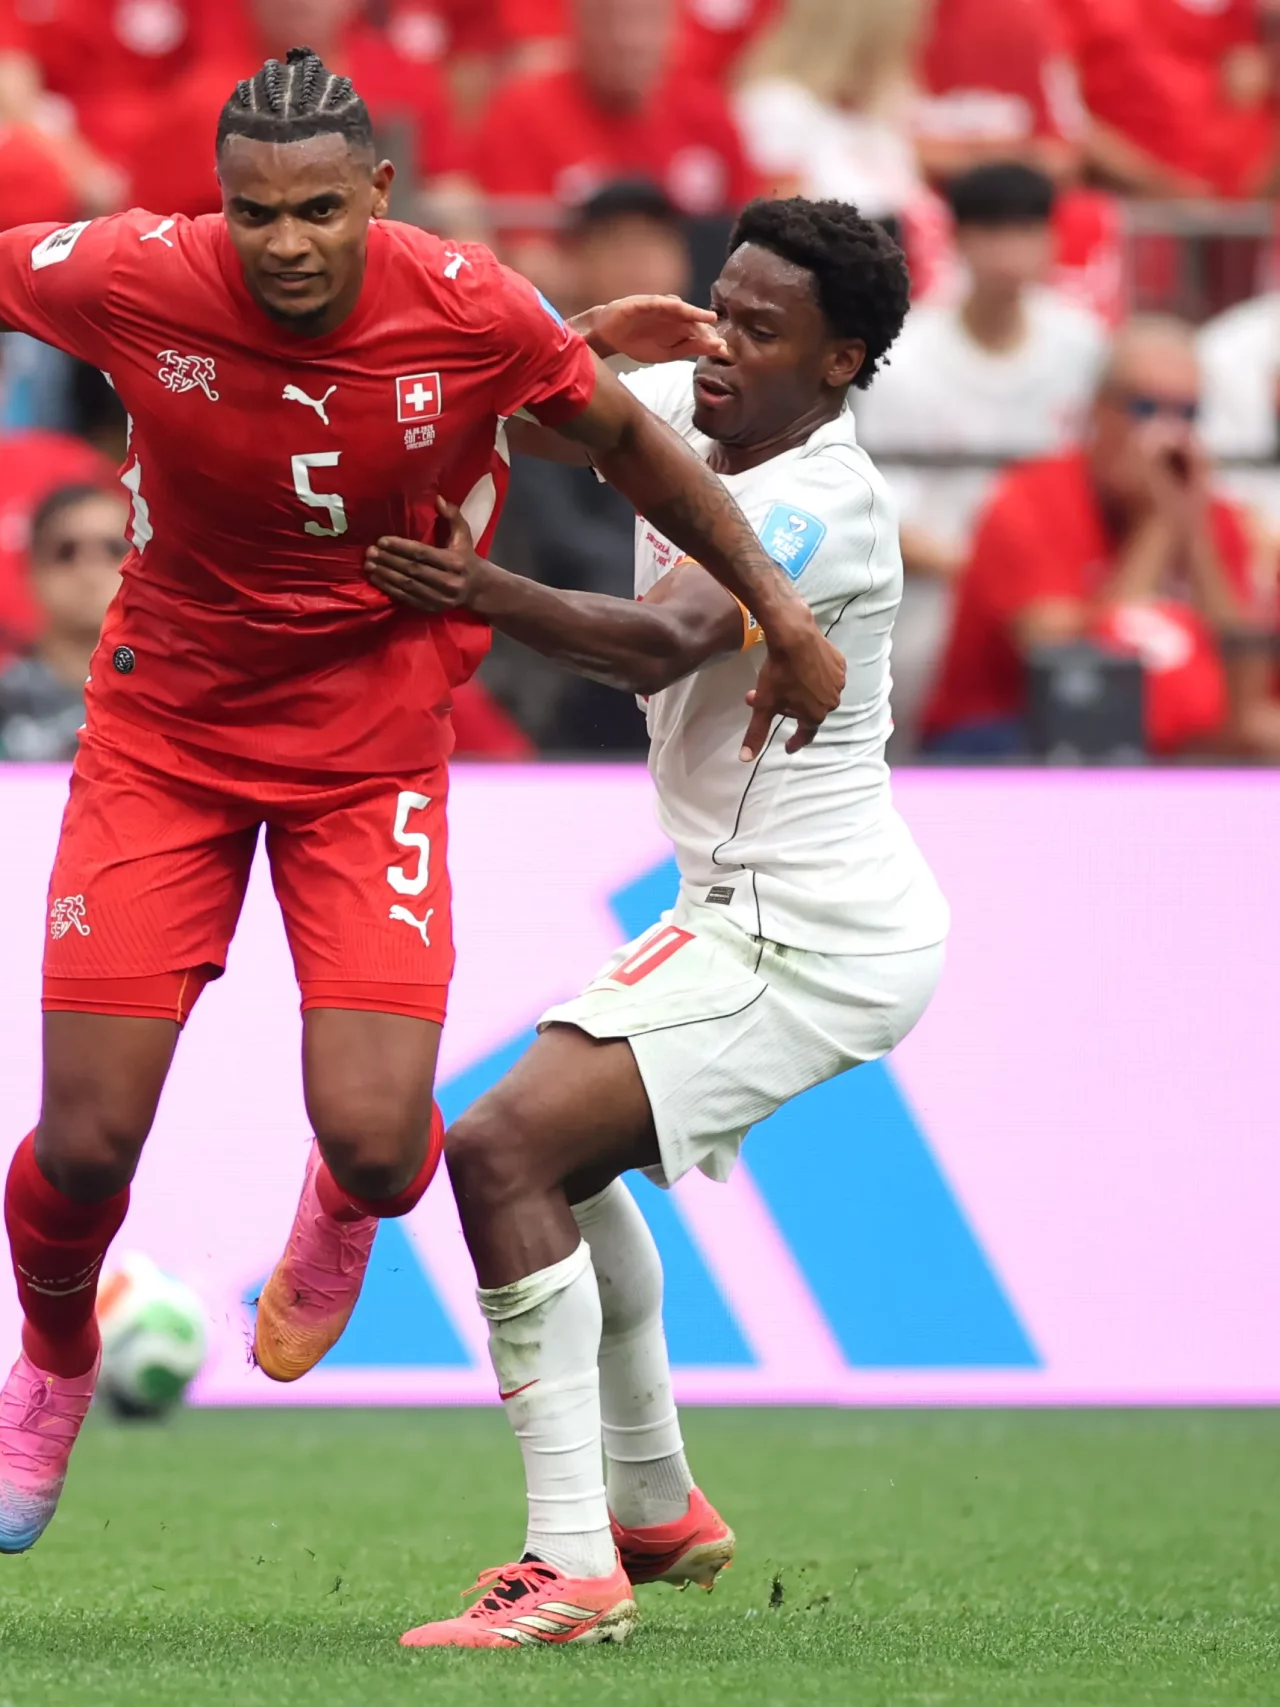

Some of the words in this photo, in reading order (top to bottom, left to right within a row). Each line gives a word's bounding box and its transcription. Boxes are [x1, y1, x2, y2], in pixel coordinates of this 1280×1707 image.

[404, 431, 416, 445] SUI
[422, 429, 435, 441] CAN
[291, 451, 348, 537] 5
[387, 790, 432, 896] 5
